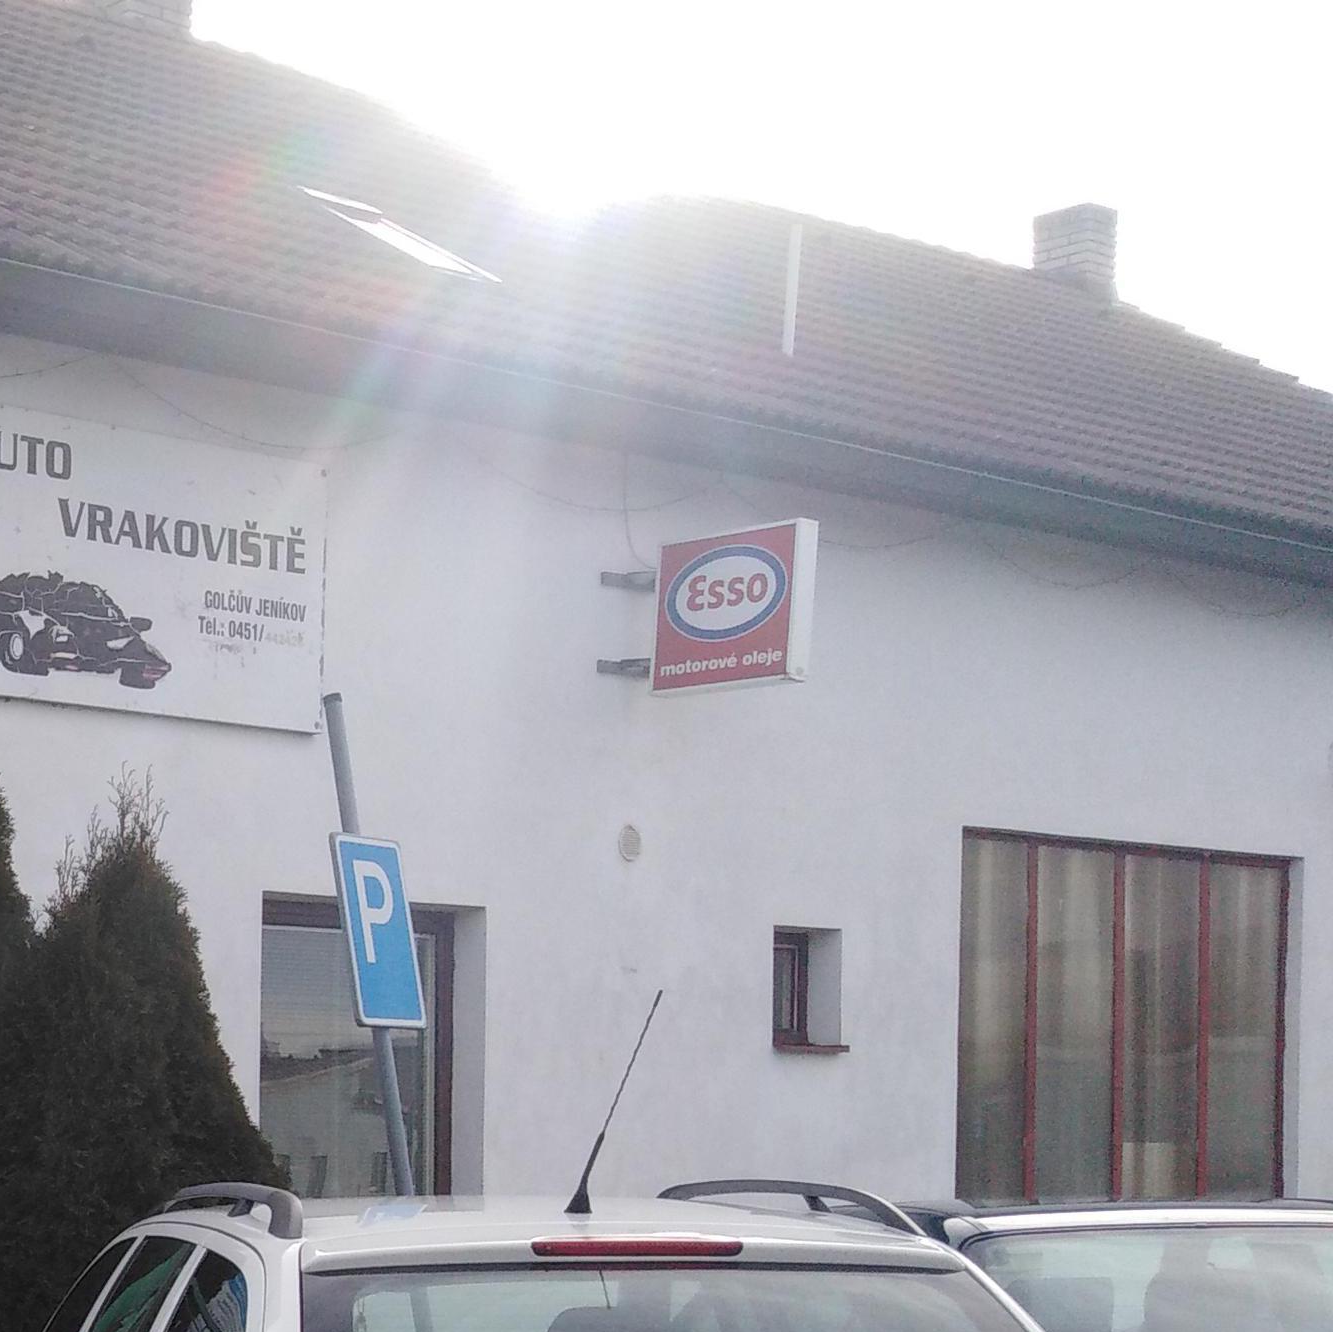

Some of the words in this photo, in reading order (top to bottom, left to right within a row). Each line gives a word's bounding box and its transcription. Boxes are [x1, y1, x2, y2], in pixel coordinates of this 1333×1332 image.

[58, 498, 306, 574] VRAKOVIŠTĚ
[204, 589, 252, 614] GOLČŮV
[255, 597, 307, 622] JENÍKOV
[661, 653, 737, 677] motorové
[743, 648, 782, 667] oleje
[353, 860, 393, 964] P
